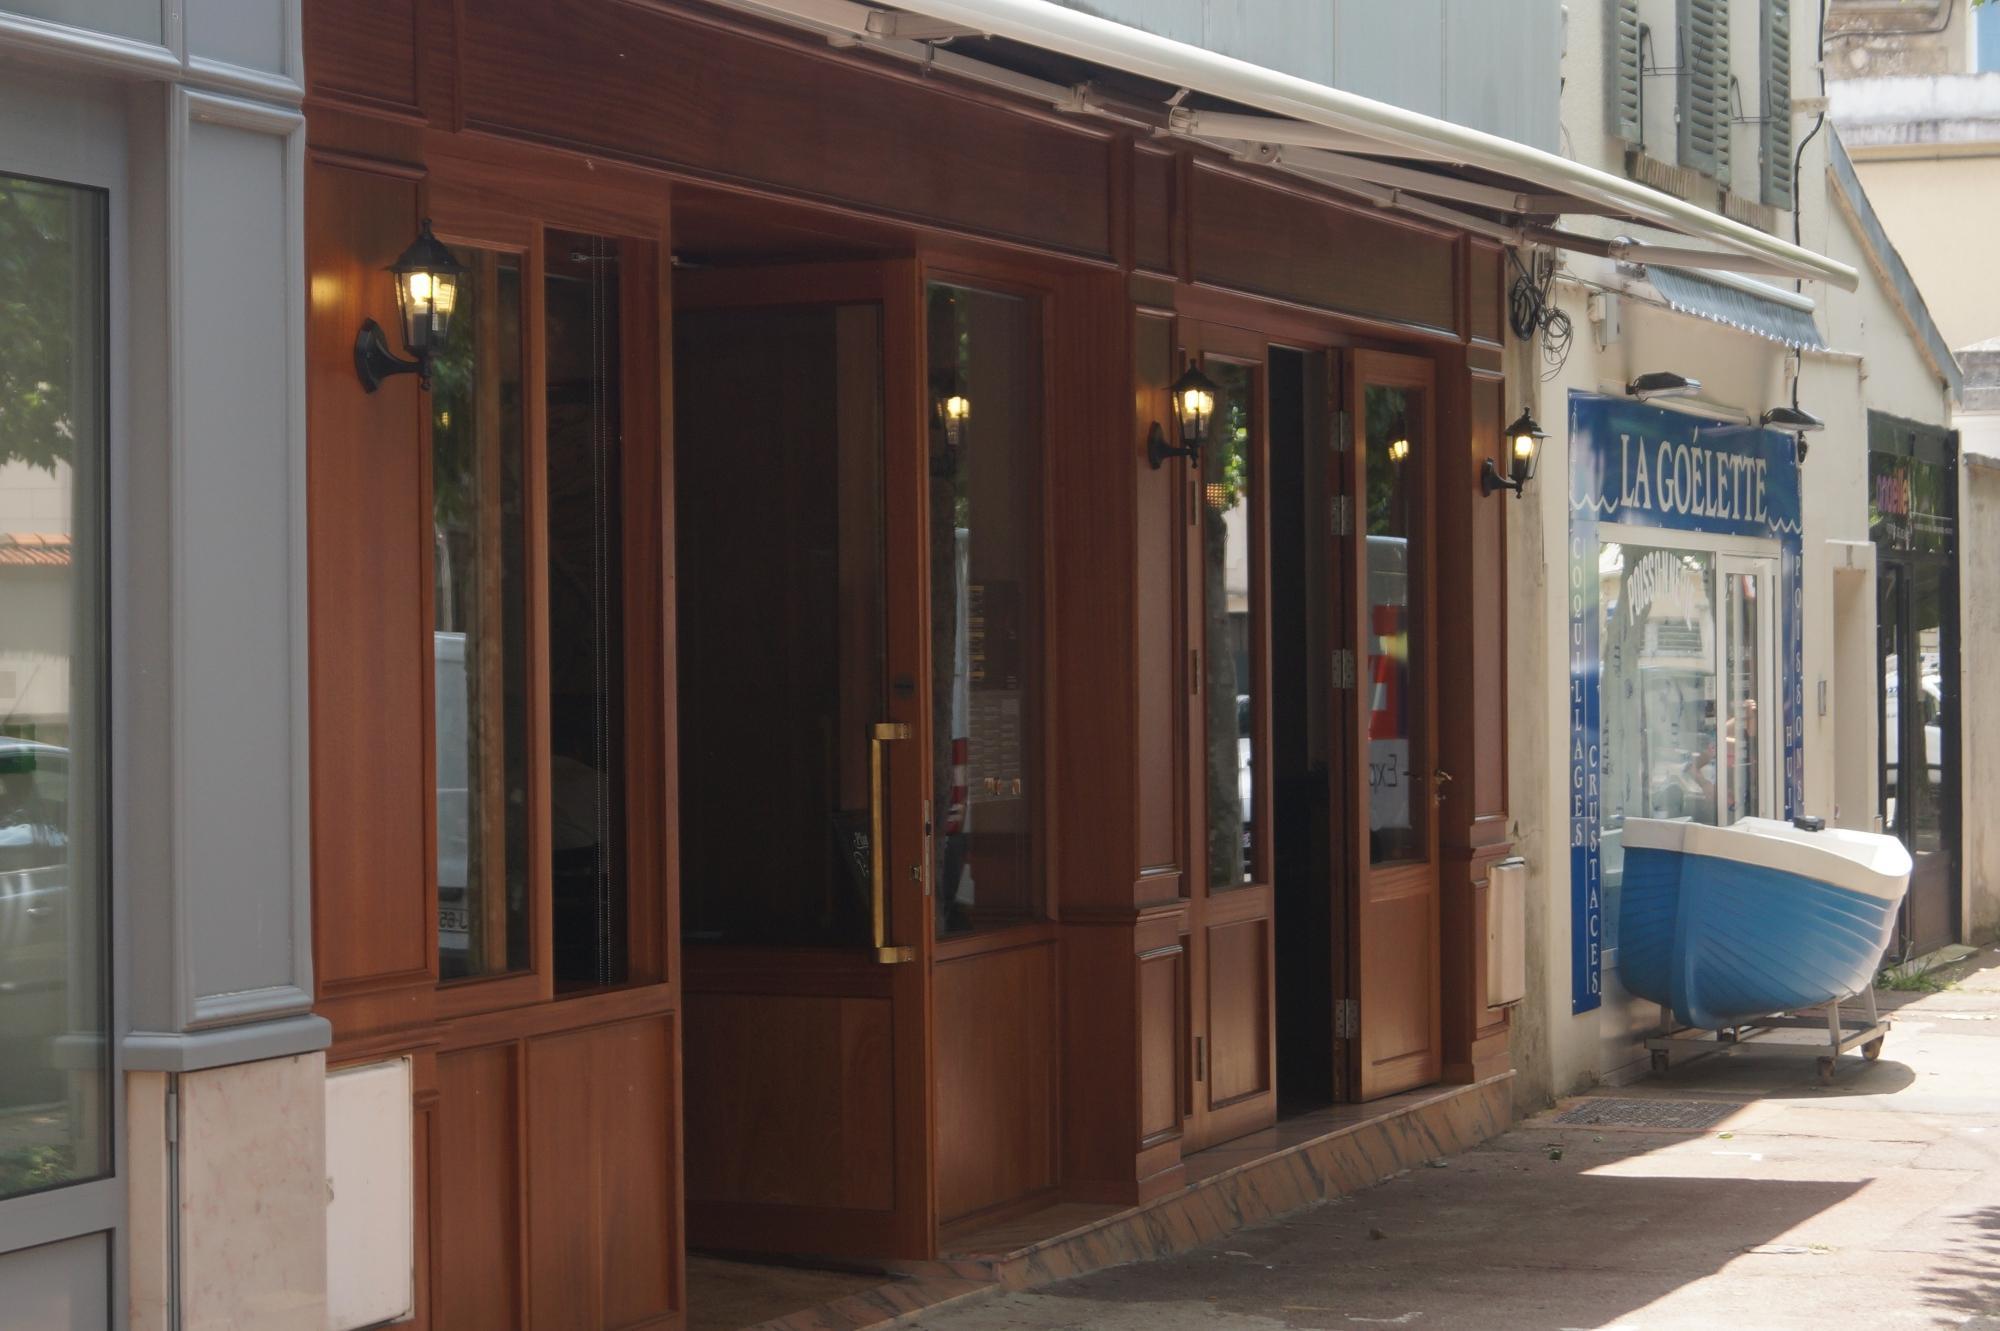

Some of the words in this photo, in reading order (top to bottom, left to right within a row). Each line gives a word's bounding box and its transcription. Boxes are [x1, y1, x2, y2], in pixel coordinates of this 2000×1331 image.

[1621, 434, 1652, 509] LA
[1657, 425, 1767, 523] GOÉLETTE
[1572, 536, 1584, 847] COQUILLAGES
[1794, 555, 1802, 801] POISSONS
[1588, 744, 1599, 994] CRUSTACES
